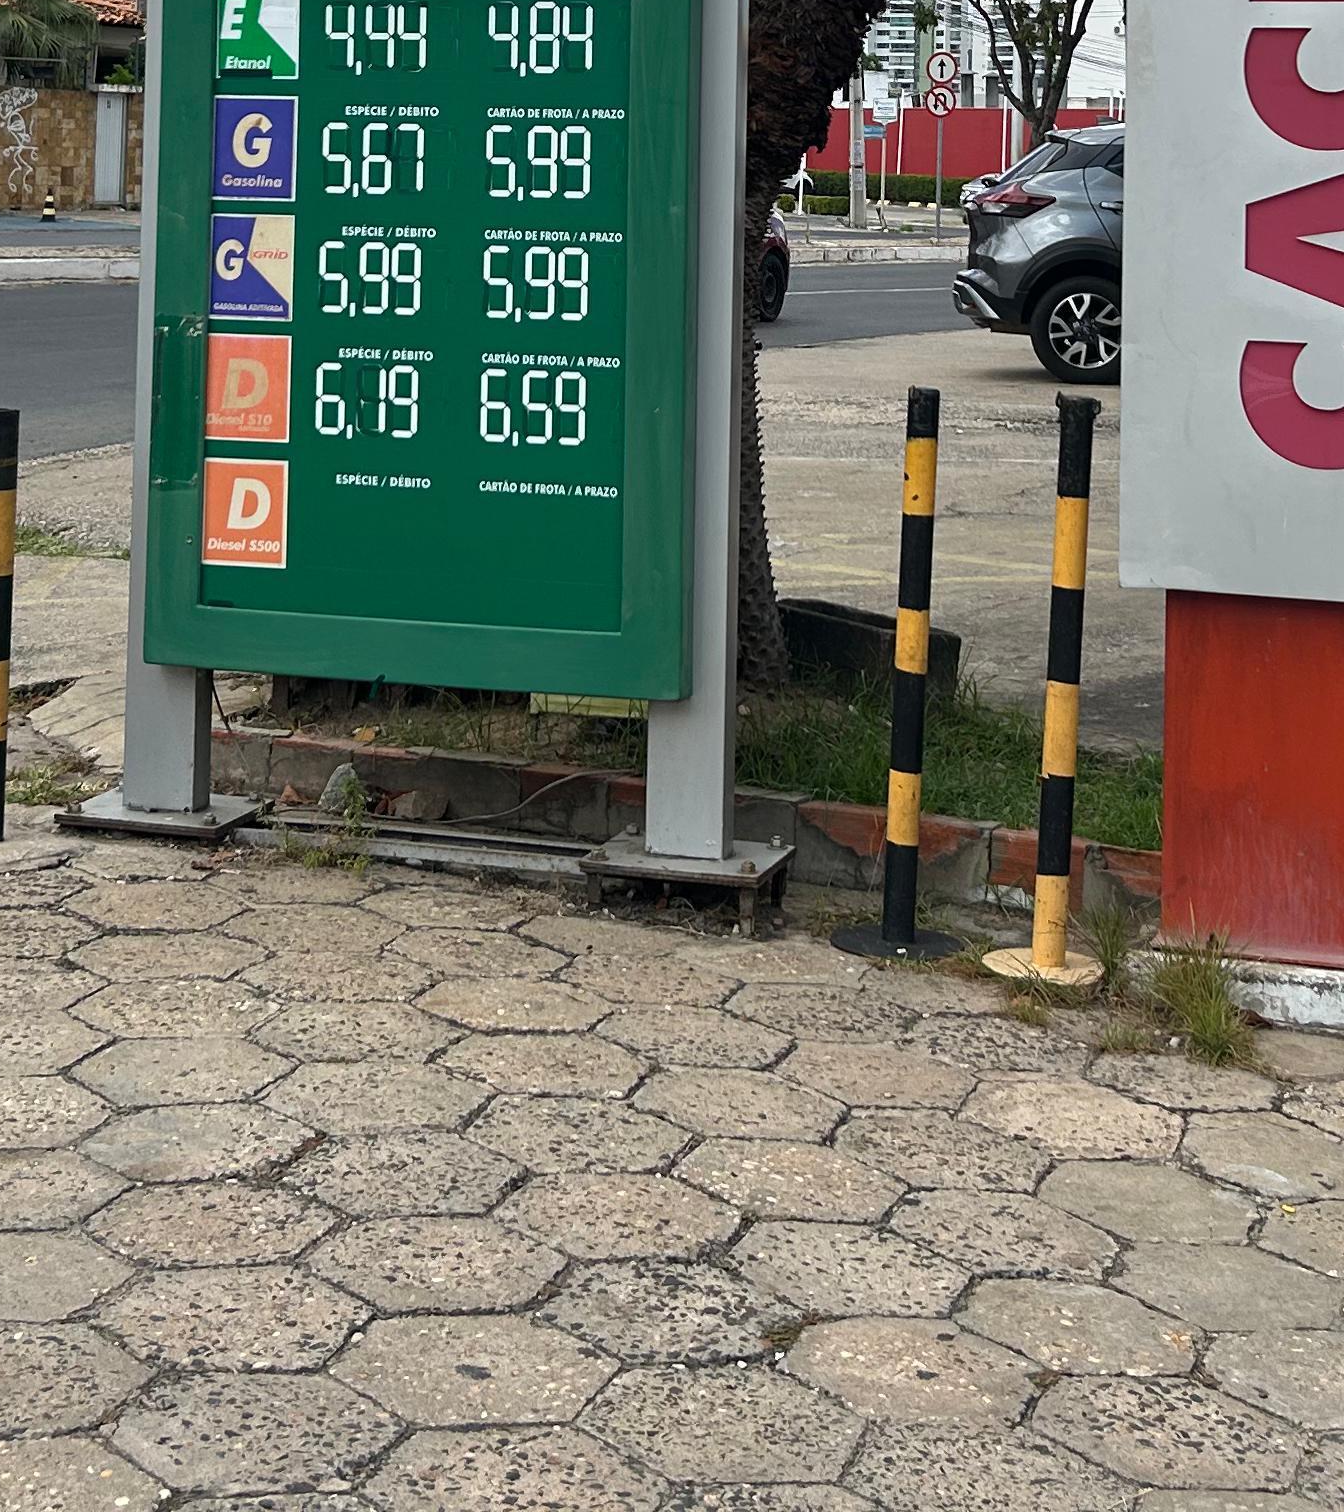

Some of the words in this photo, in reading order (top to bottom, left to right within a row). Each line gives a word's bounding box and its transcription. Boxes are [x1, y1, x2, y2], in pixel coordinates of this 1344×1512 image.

[325, 4, 427, 76] 4,44
[488, 1, 594, 77] 4,84
[225, 55, 271, 70] Etanol
[345, 104, 388, 116] ESPÉCIE
[398, 104, 440, 117] DÉBITO
[487, 106, 525, 118] CARTÃO
[528, 108, 539, 118] DE
[543, 109, 574, 119] FROTA
[582, 109, 589, 119] A
[592, 109, 625, 119] PRAZO
[232, 112, 273, 168] G
[322, 122, 425, 198] 5,67
[486, 124, 591, 202] 5,99
[221, 174, 283, 188] Gasolina
[342, 224, 385, 237] ESPÉCIE
[395, 225, 436, 238] DÉBITO
[484, 228, 523, 241] CARTÃO
[525, 230, 537, 241] DE
[540, 231, 571, 241] FROTA
[579, 232, 587, 242] A
[590, 232, 623, 243] PRAZO
[215, 238, 245, 281] G
[318, 241, 422, 318] 5,99
[483, 245, 589, 323] 5,99
[338, 346, 381, 360] ESPÉCIE
[392, 348, 434, 361] DÉBITO
[481, 352, 520, 364] CARTÃO
[522, 355, 535, 365] DE
[537, 355, 568, 366] FROTA
[577, 356, 585, 367] A
[587, 356, 620, 368] PRAZO
[221, 357, 269, 409] D
[315, 362, 419, 440] 6,19
[480, 368, 586, 447] 6,59
[206, 413, 244, 425] Diesel
[248, 414, 272, 425] S10
[335, 473, 378, 486] ESPÉCIE
[389, 474, 431, 489] DÉBITO
[479, 480, 517, 493] CARTÃO
[519, 483, 532, 493] DE
[535, 483, 565, 495] FROTA
[574, 485, 582, 496] A
[585, 486, 618, 498] PRAZO
[226, 477, 272, 529] D
[207, 537, 245, 551] Diesel
[249, 539, 280, 553] S500
